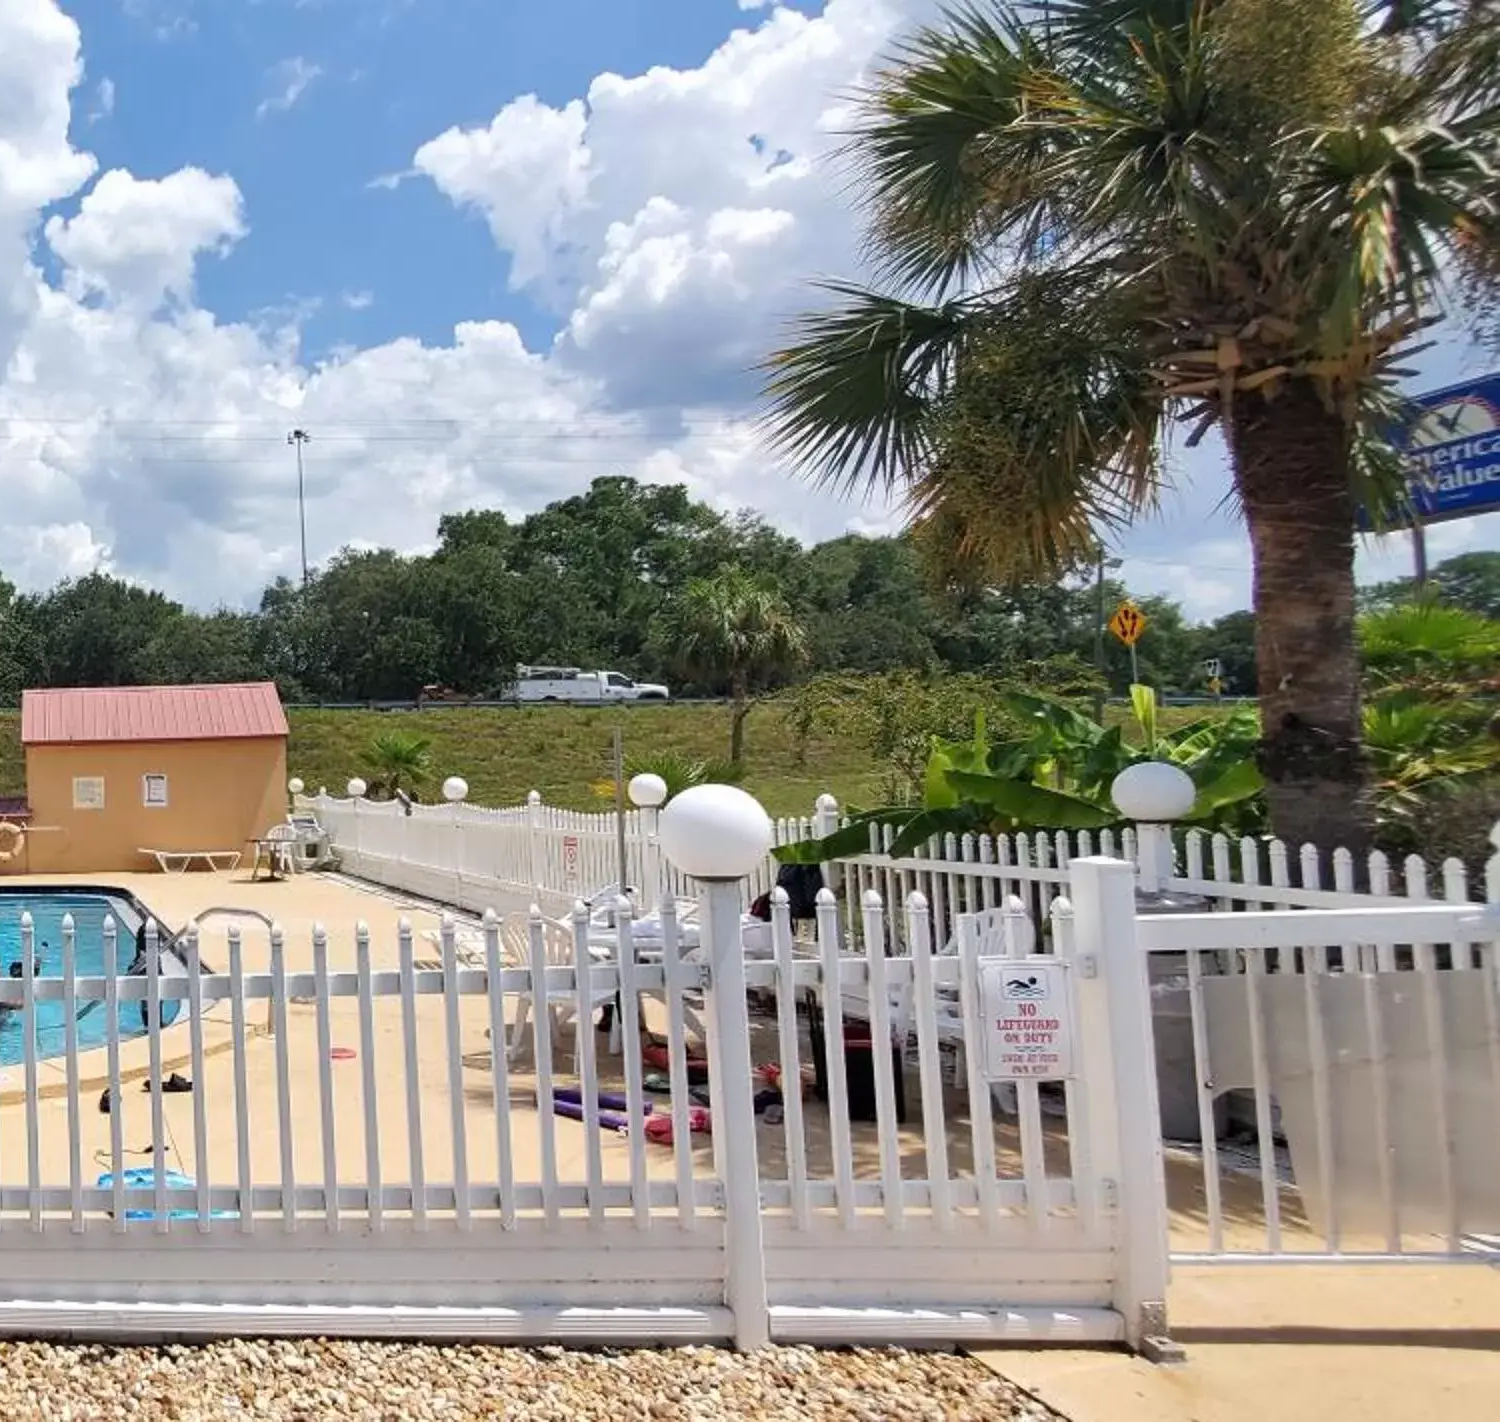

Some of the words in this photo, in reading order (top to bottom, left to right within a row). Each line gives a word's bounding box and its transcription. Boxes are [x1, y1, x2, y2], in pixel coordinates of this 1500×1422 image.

[1018, 1003, 1036, 1016] NO
[996, 1019, 1060, 1031] LIFEGUARD
[1004, 1032, 1020, 1043] ON
[1023, 1032, 1053, 1043] DUTY
